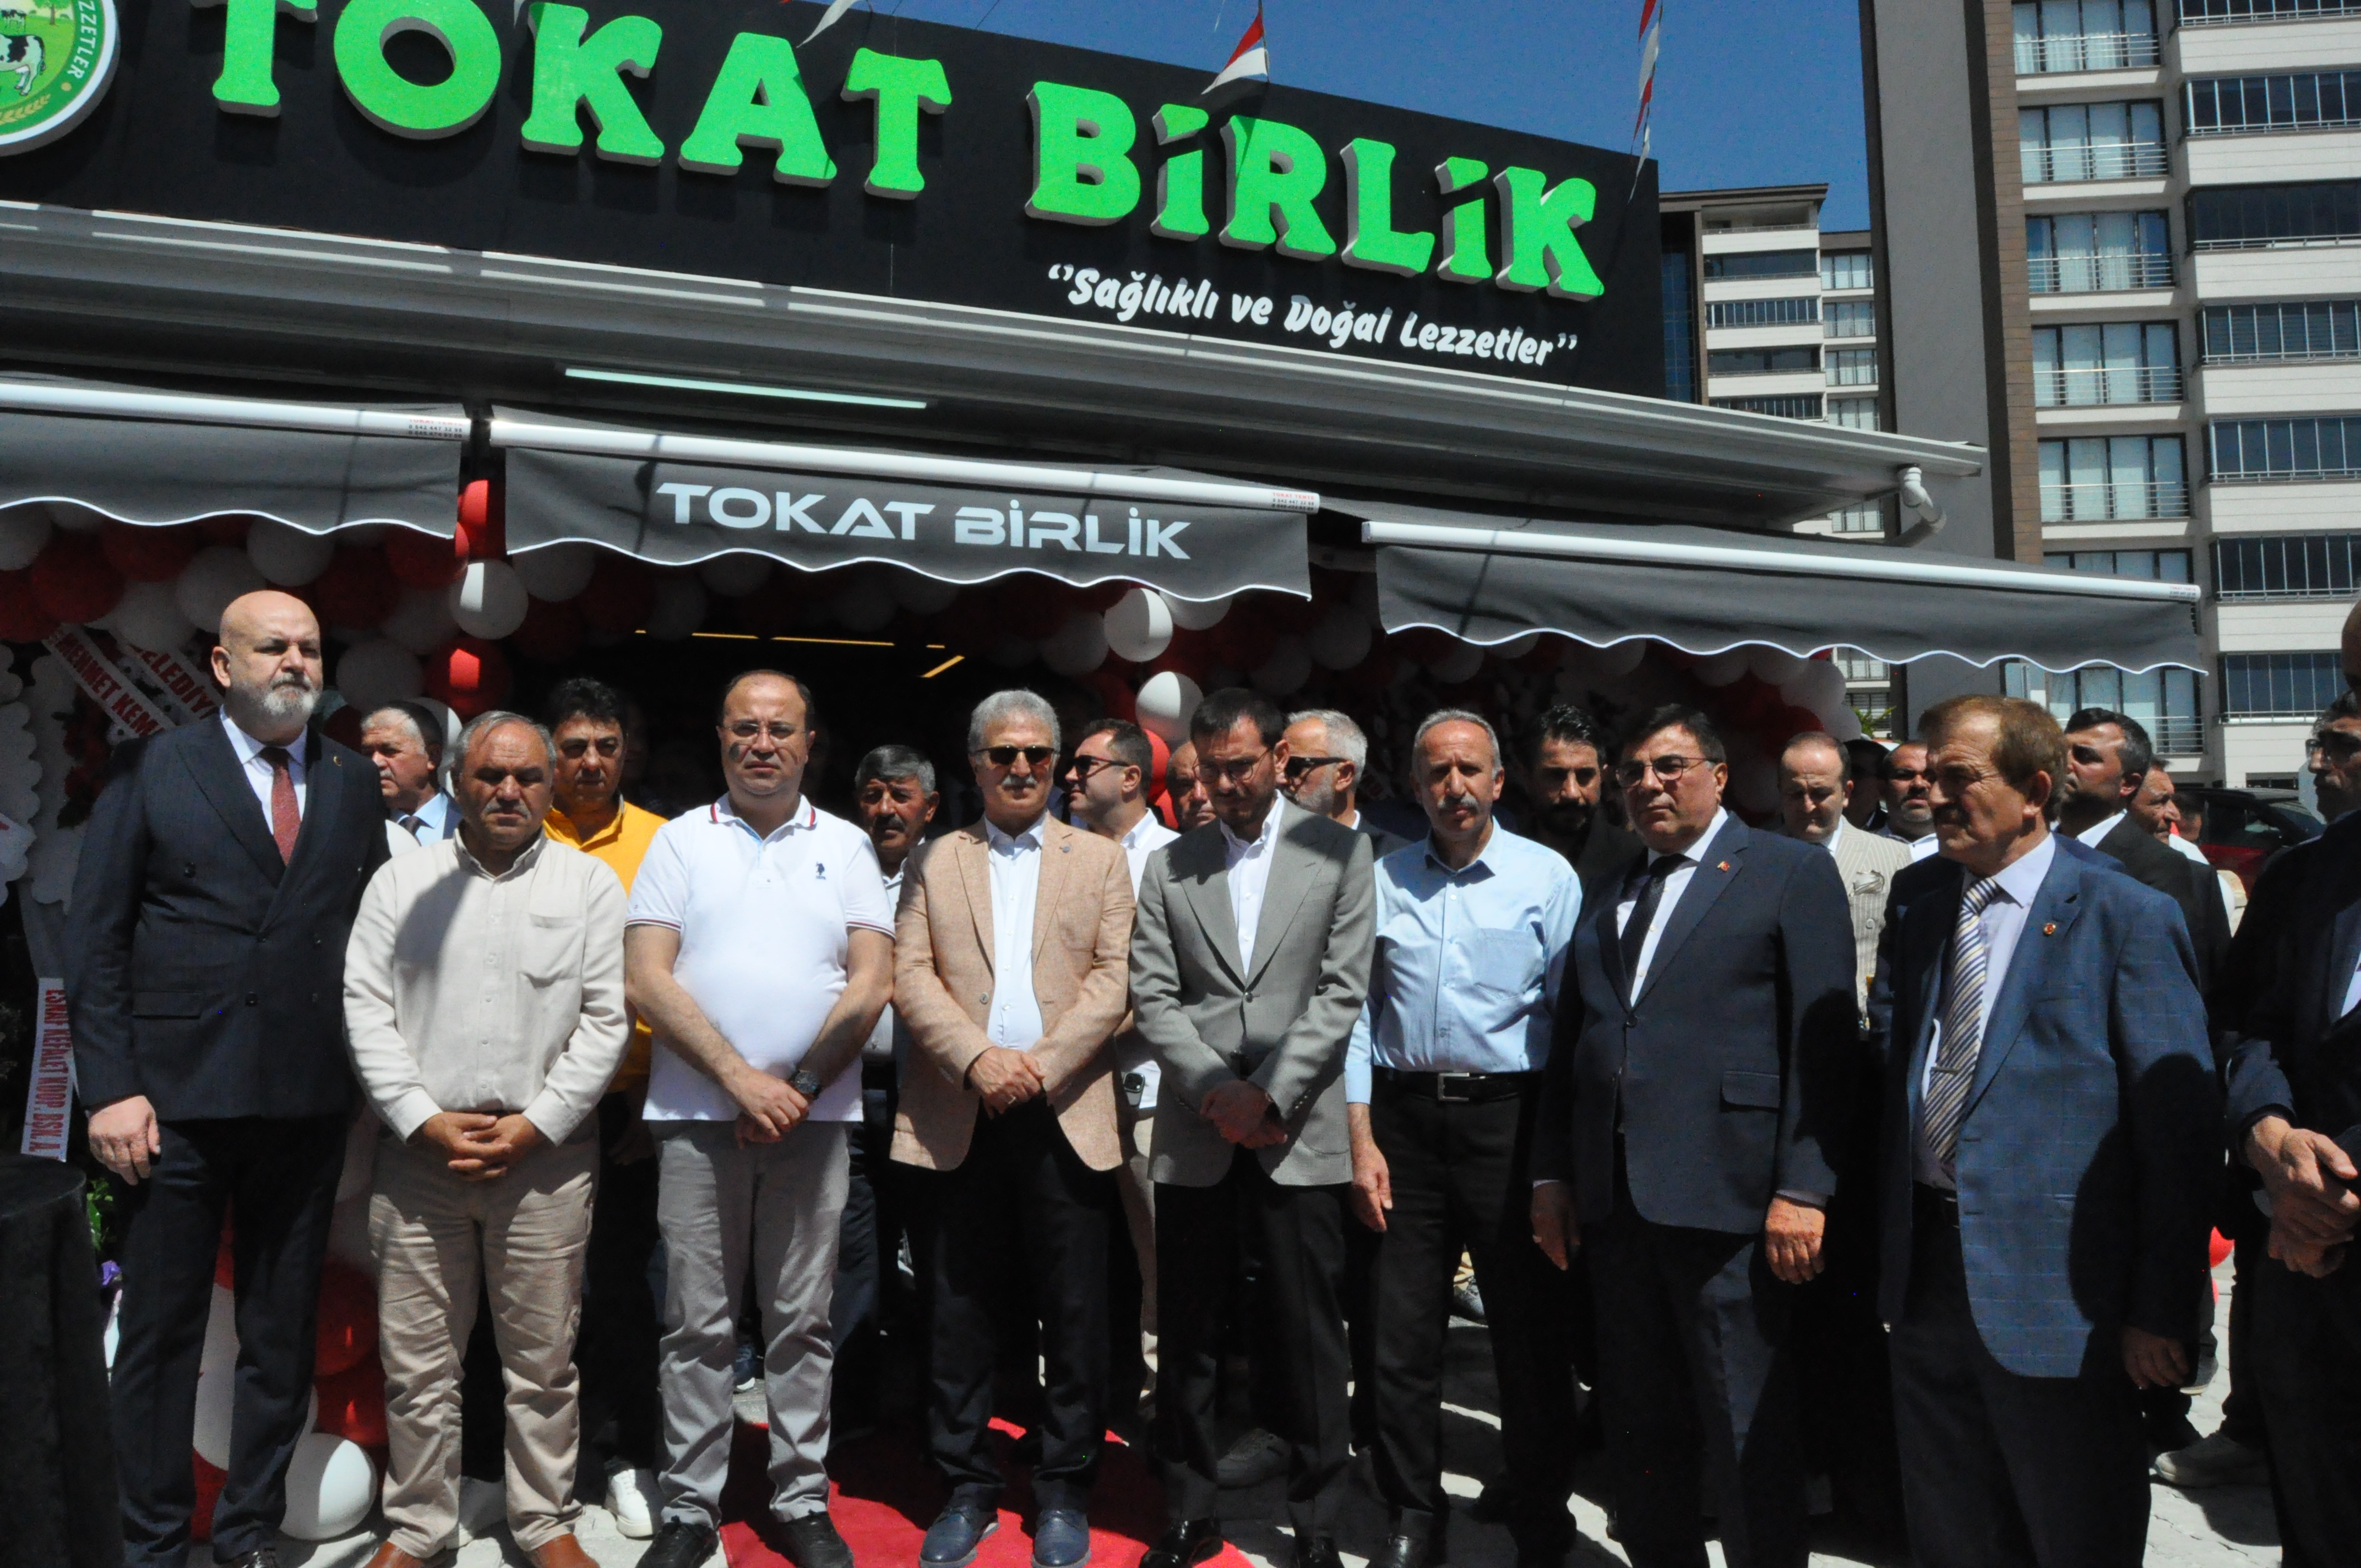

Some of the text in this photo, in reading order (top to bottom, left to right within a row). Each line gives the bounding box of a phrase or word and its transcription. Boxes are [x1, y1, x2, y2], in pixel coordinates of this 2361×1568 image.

[190, 0, 1604, 302] TOKAT BİRLİK
[1231, 293, 1273, 325] ve
[1283, 294, 1393, 349] Doğal
[655, 482, 1192, 559] TOKAT BİRLİK
[56, 633, 165, 737] MEHMET KEM
[128, 643, 219, 720] ELEDİY
